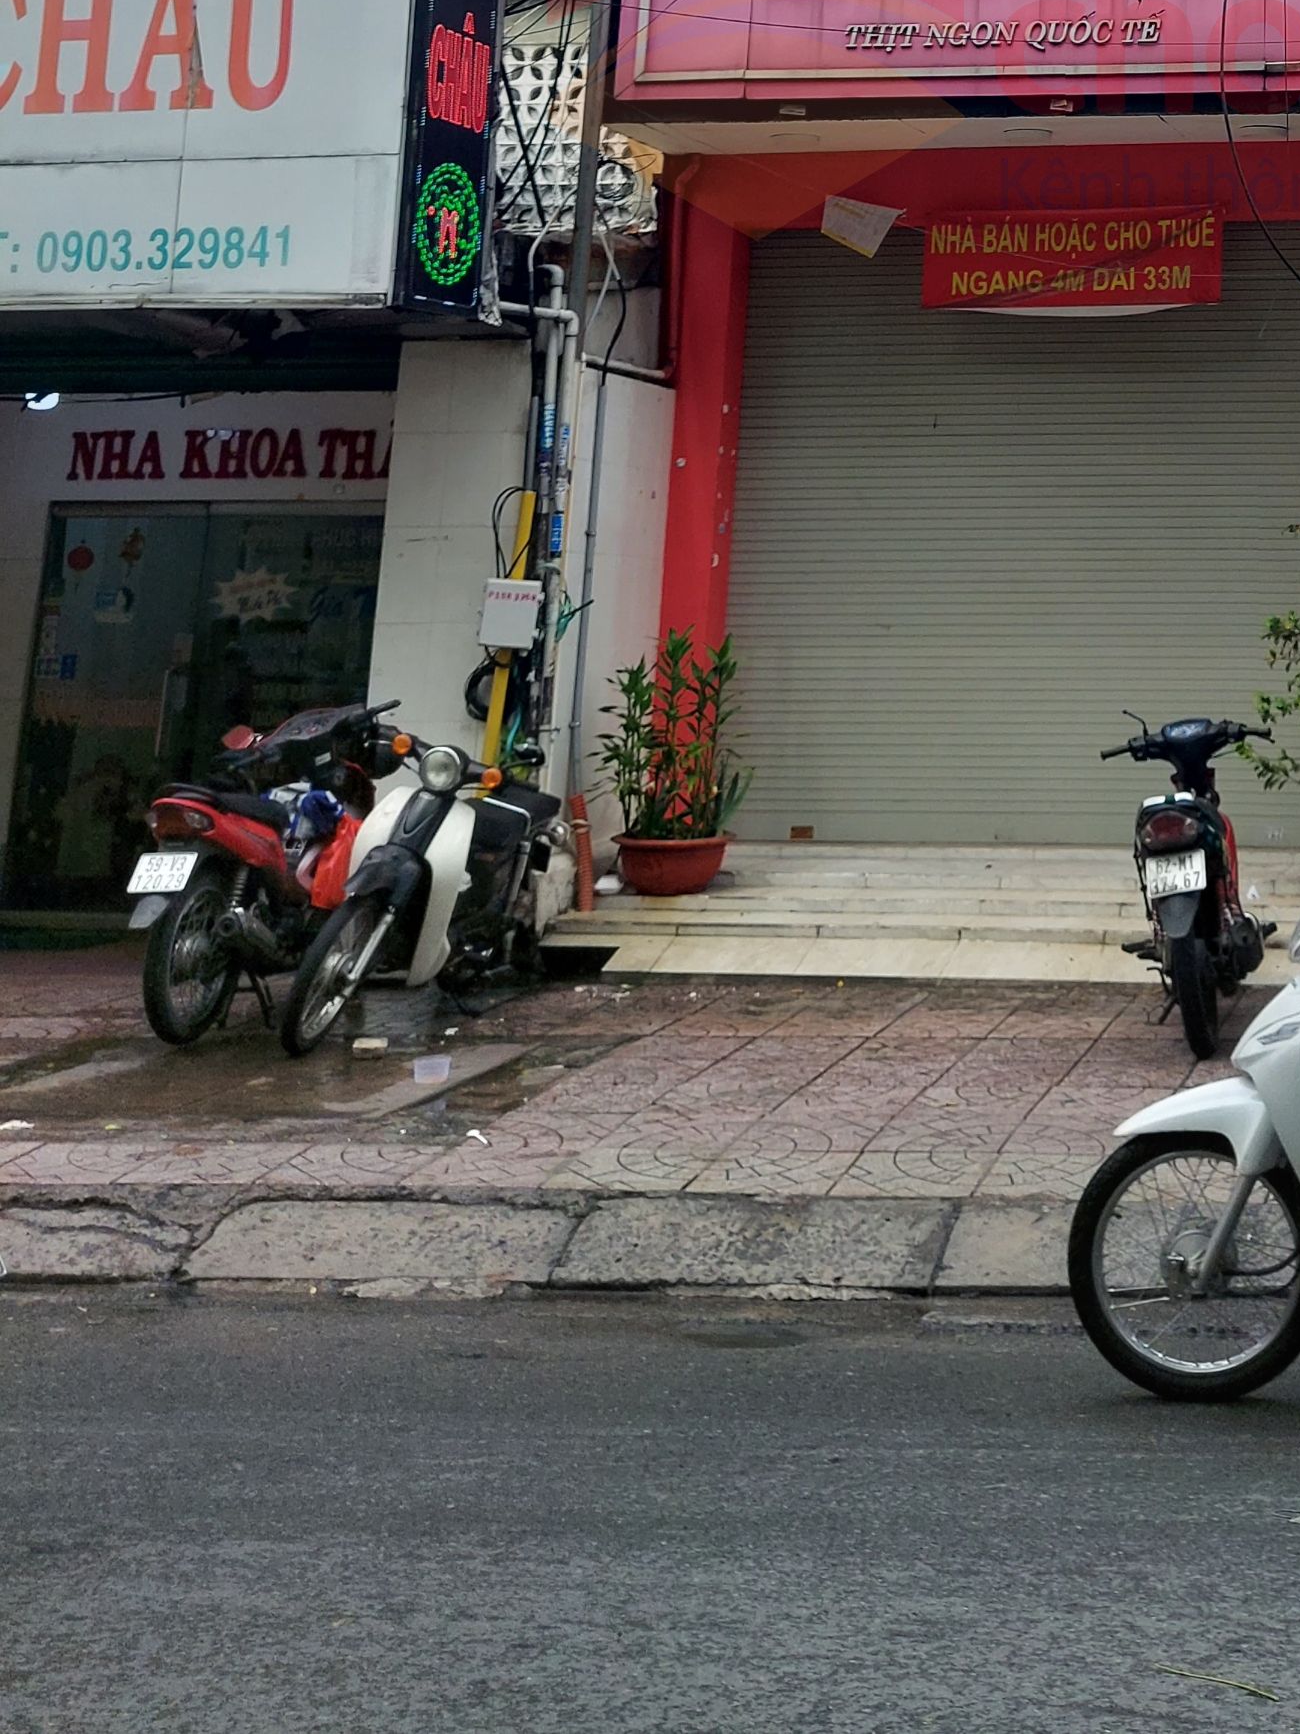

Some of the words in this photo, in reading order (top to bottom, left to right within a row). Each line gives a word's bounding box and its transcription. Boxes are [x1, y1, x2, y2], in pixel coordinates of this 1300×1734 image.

[844, 22, 921, 53] THỊT
[923, 19, 1018, 48] NGON
[1025, 9, 1116, 51] QUỐC
[1119, 9, 1166, 44] TẾ
[428, 10, 490, 134] CHÂU
[37, 224, 291, 274] 0903.329841
[931, 217, 976, 254] NHÀ
[983, 216, 1028, 253] BÁN
[1035, 218, 1097, 259] HOẶC
[1104, 219, 1151, 251] CHO
[952, 269, 1044, 296] NGANG
[1050, 267, 1085, 293] 4M
[1144, 266, 1191, 291] 33M
[66, 429, 165, 481] NHA
[179, 428, 307, 480] KHOA
